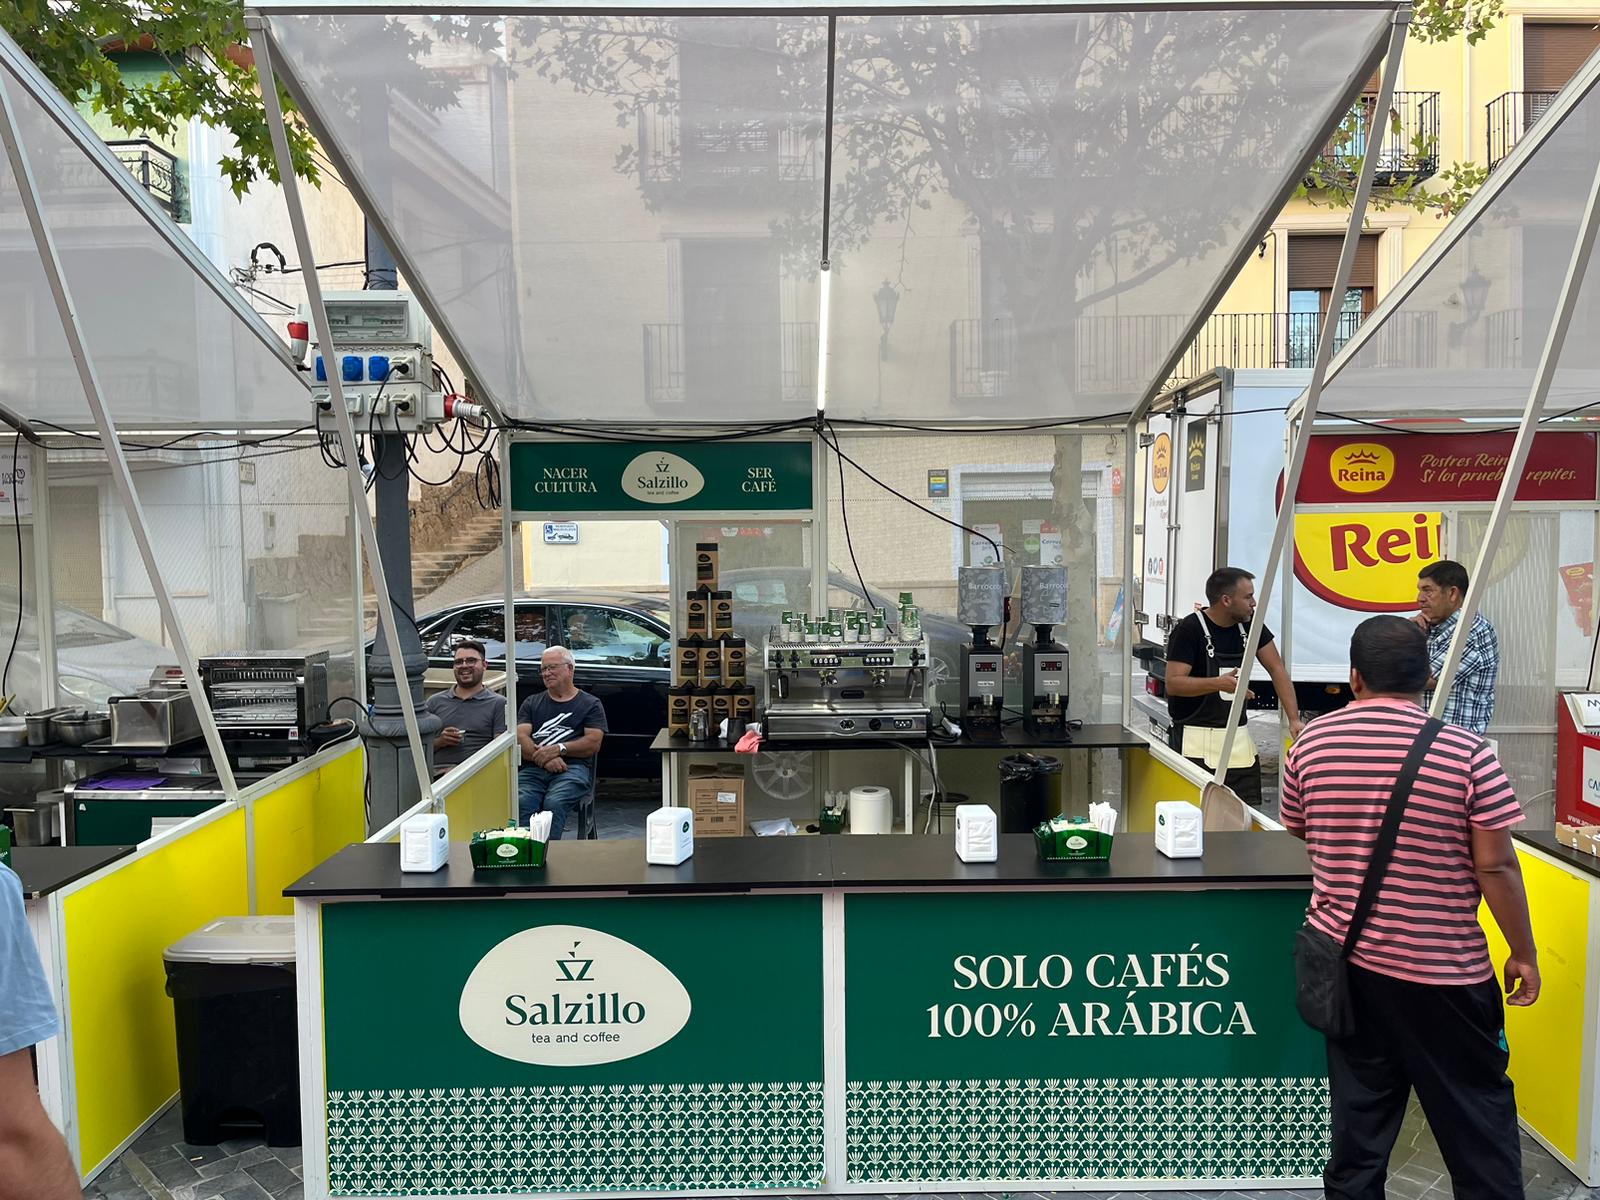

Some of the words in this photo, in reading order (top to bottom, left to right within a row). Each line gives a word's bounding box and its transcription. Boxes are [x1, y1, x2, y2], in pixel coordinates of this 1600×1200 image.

[1419, 453, 1472, 468] Postres
[1474, 452, 1509, 467] Rein
[543, 467, 588, 480] NACER
[747, 467, 773, 479] SER
[1338, 467, 1386, 482] Reina
[1420, 468, 1436, 484] Si
[1438, 468, 1456, 482] los
[1458, 467, 1505, 488] prueb
[1526, 467, 1577, 487] repites.
[534, 481, 598, 493] CULTURA
[637, 476, 688, 489] Salzillo
[741, 478, 777, 493] CAFÉ
[1330, 513, 1440, 571] Rei
[953, 954, 1073, 990] SOLO
[1085, 942, 1230, 989] CAFÉS
[505, 992, 646, 1026] Salzillo
[926, 1002, 1036, 1038] 100%
[1047, 990, 1257, 1036] ARÁBICA
[531, 1033, 550, 1043] tea
[556, 1032, 578, 1043] and
[583, 1031, 621, 1043] coffee
